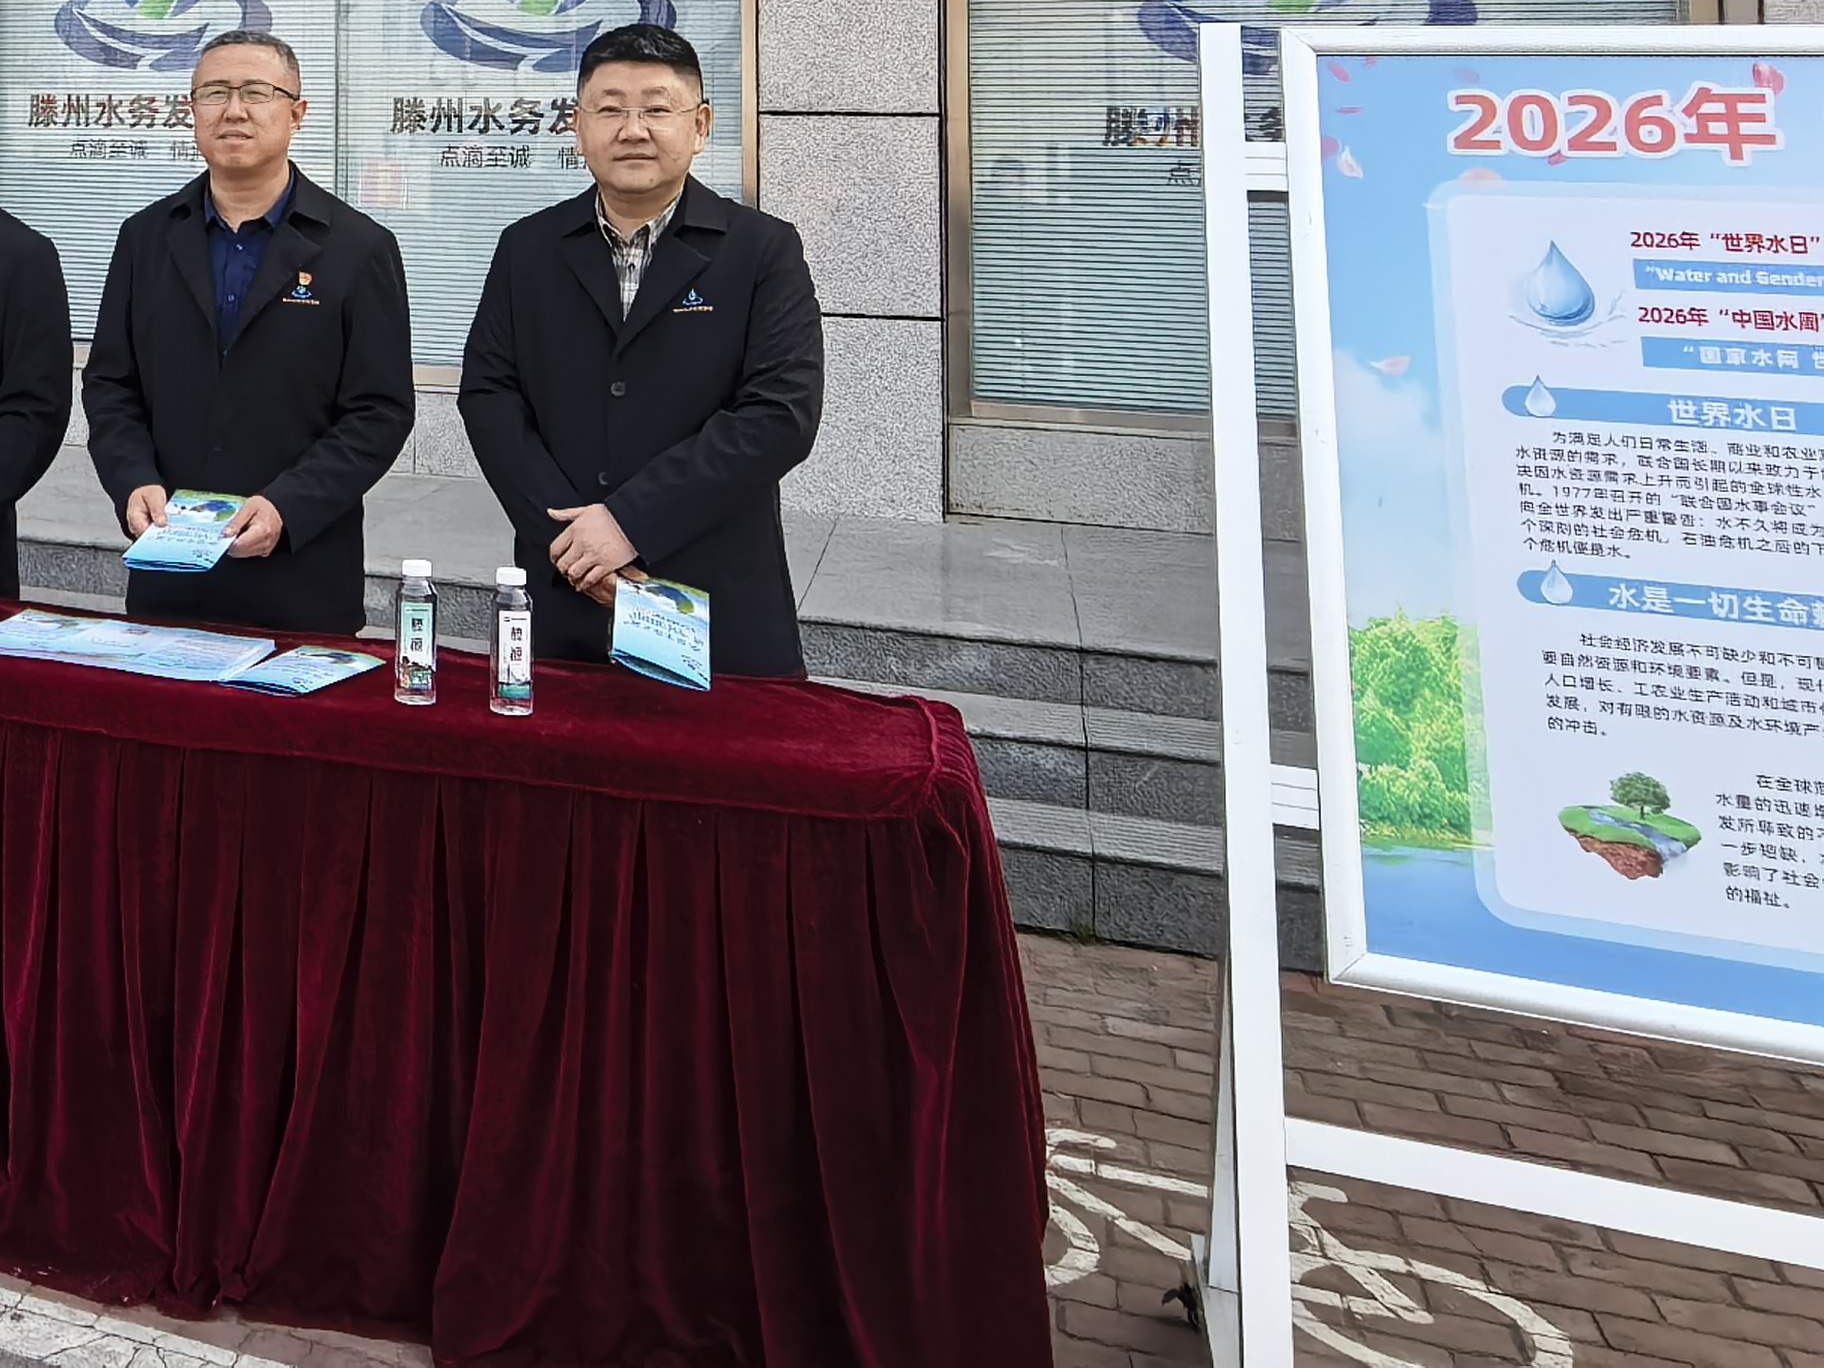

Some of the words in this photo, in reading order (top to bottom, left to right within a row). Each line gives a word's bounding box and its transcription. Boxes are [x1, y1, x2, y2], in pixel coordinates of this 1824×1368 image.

[1453, 86, 1777, 161] 2026年
[441, 144, 531, 169] 点滴至诚
[558, 146, 587, 170] 情
[1630, 231, 1701, 250] 2026年
[1716, 270, 1752, 285] and
[1638, 306, 1709, 326] 2026年
[1667, 398, 1797, 432] 世界水日
